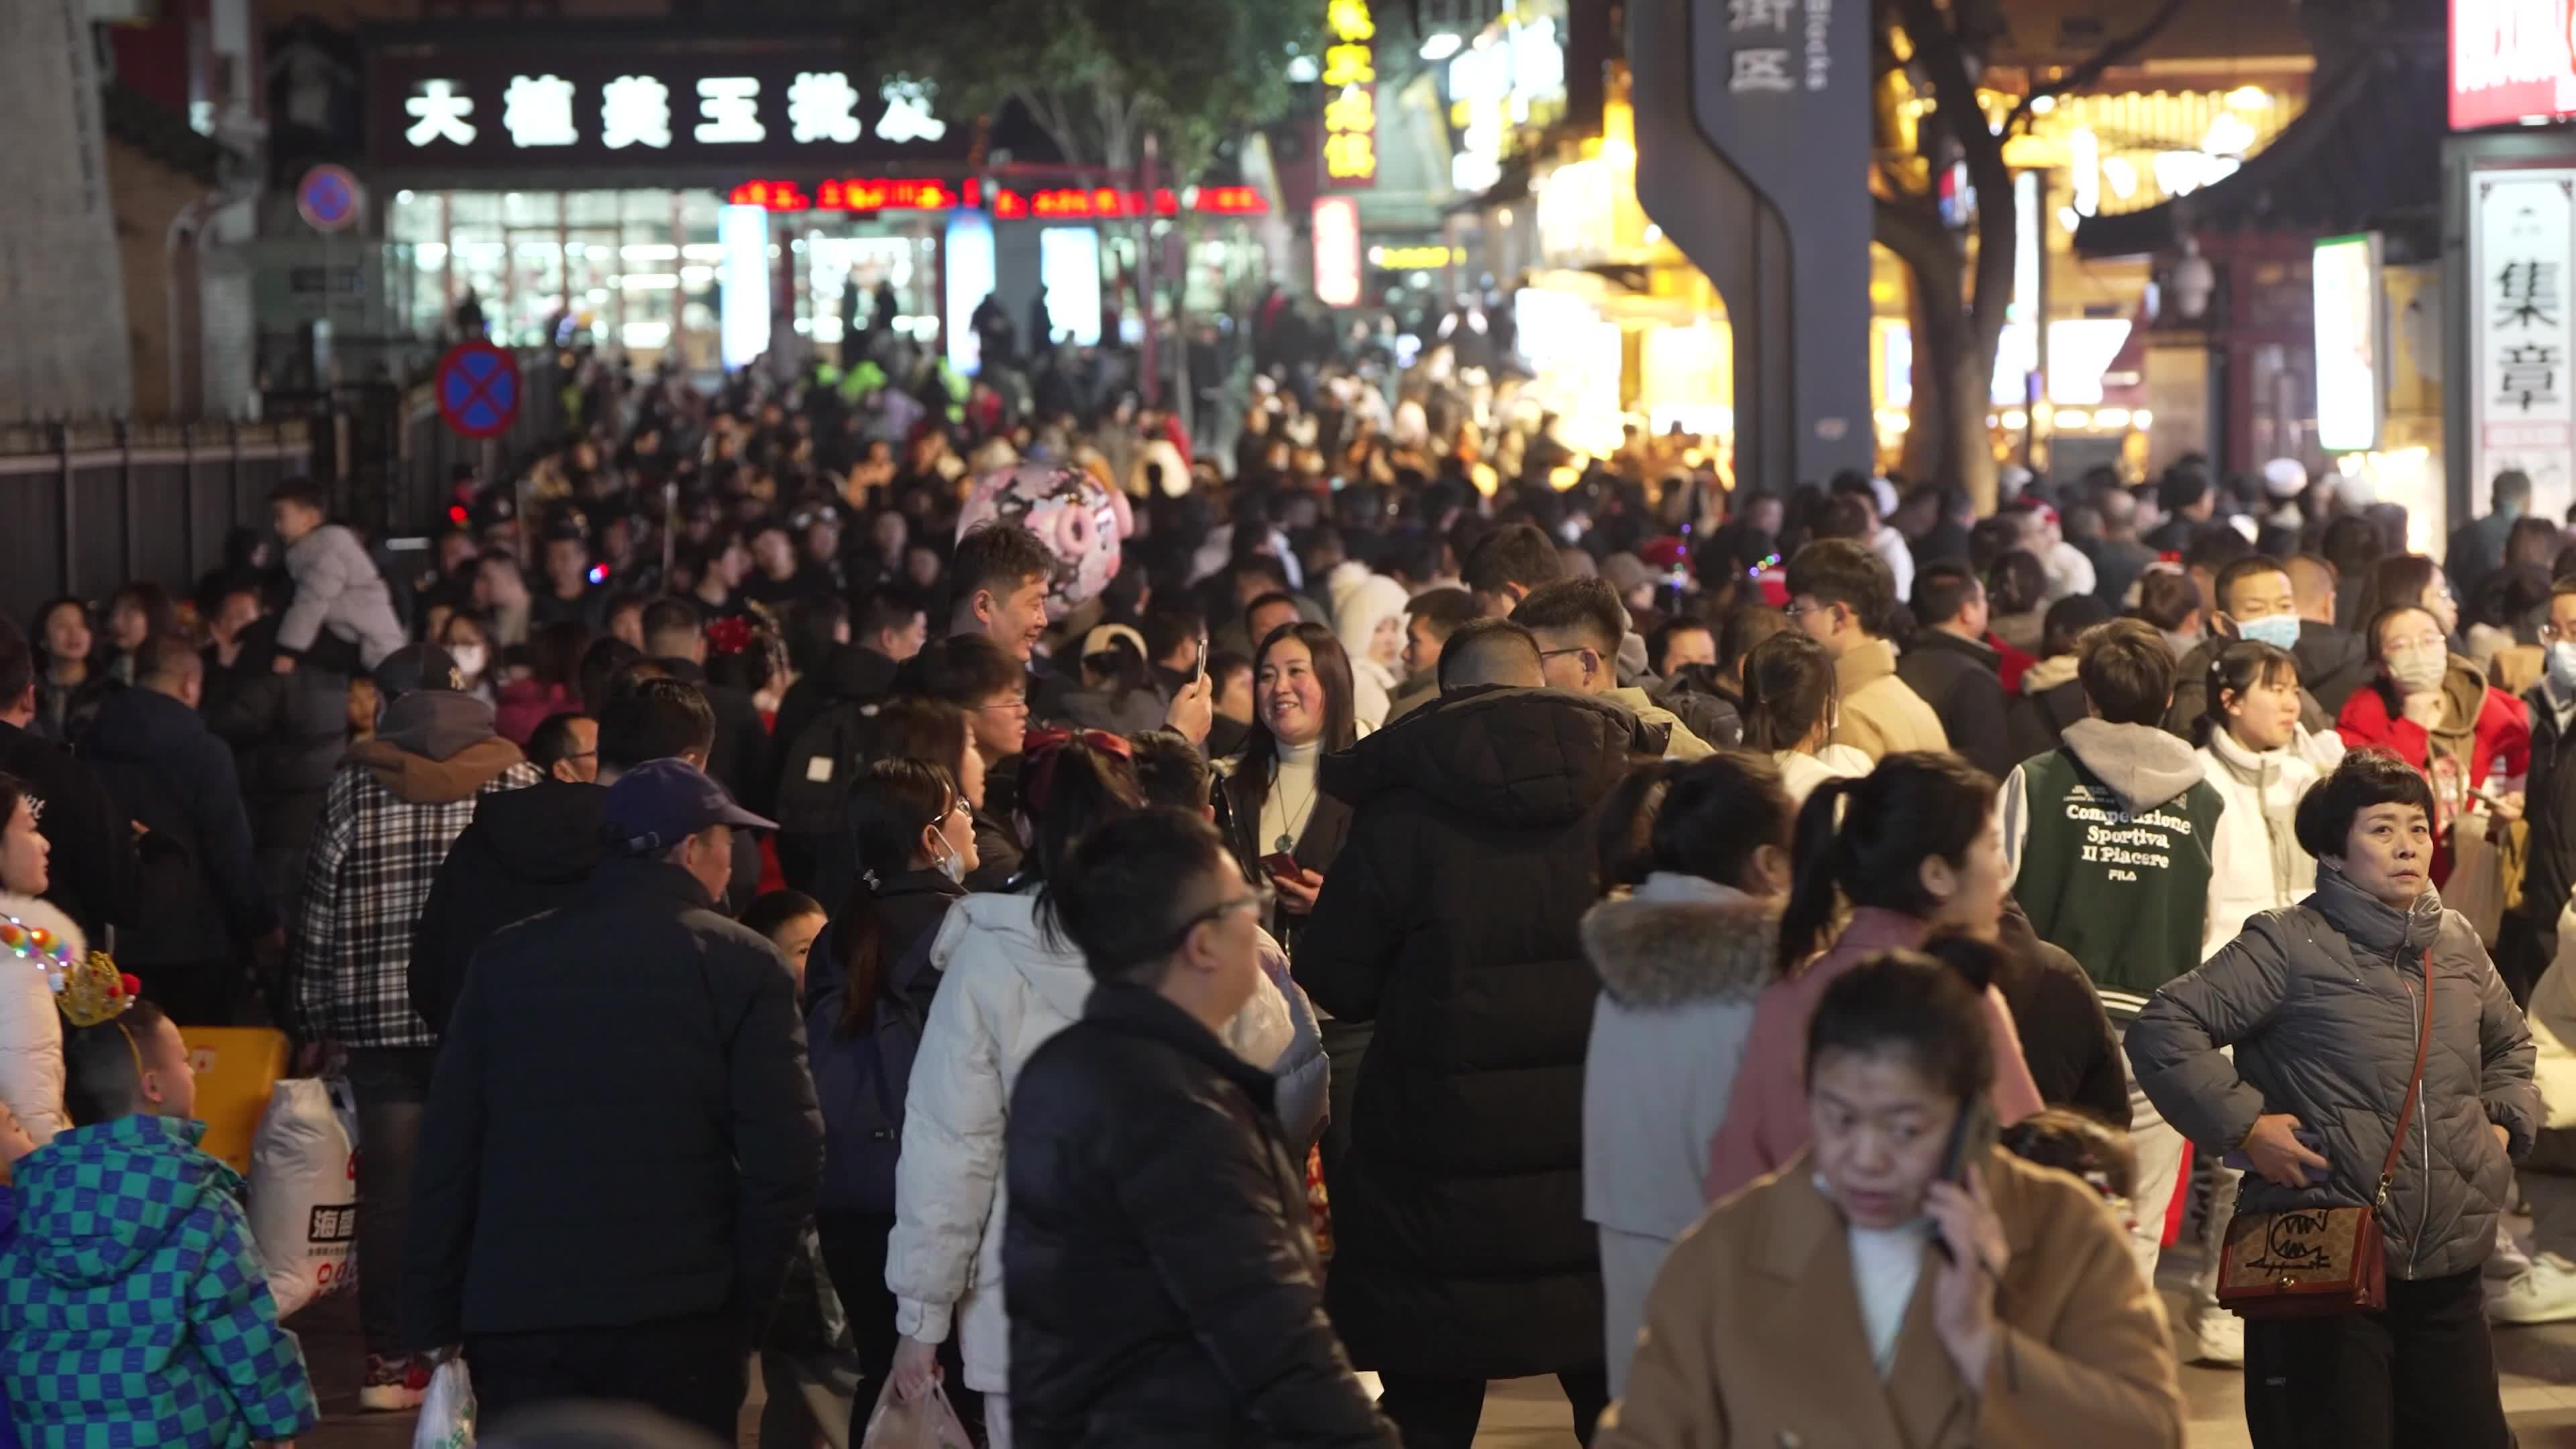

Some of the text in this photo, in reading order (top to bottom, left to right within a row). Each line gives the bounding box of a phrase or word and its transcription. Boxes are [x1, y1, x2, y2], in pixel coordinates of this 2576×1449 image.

[2493, 259, 2561, 412] 集章
[2087, 825, 2171, 849] Sportiva
[2081, 845, 2170, 868] Il Piacere
[2108, 869, 2137, 881] FILA
